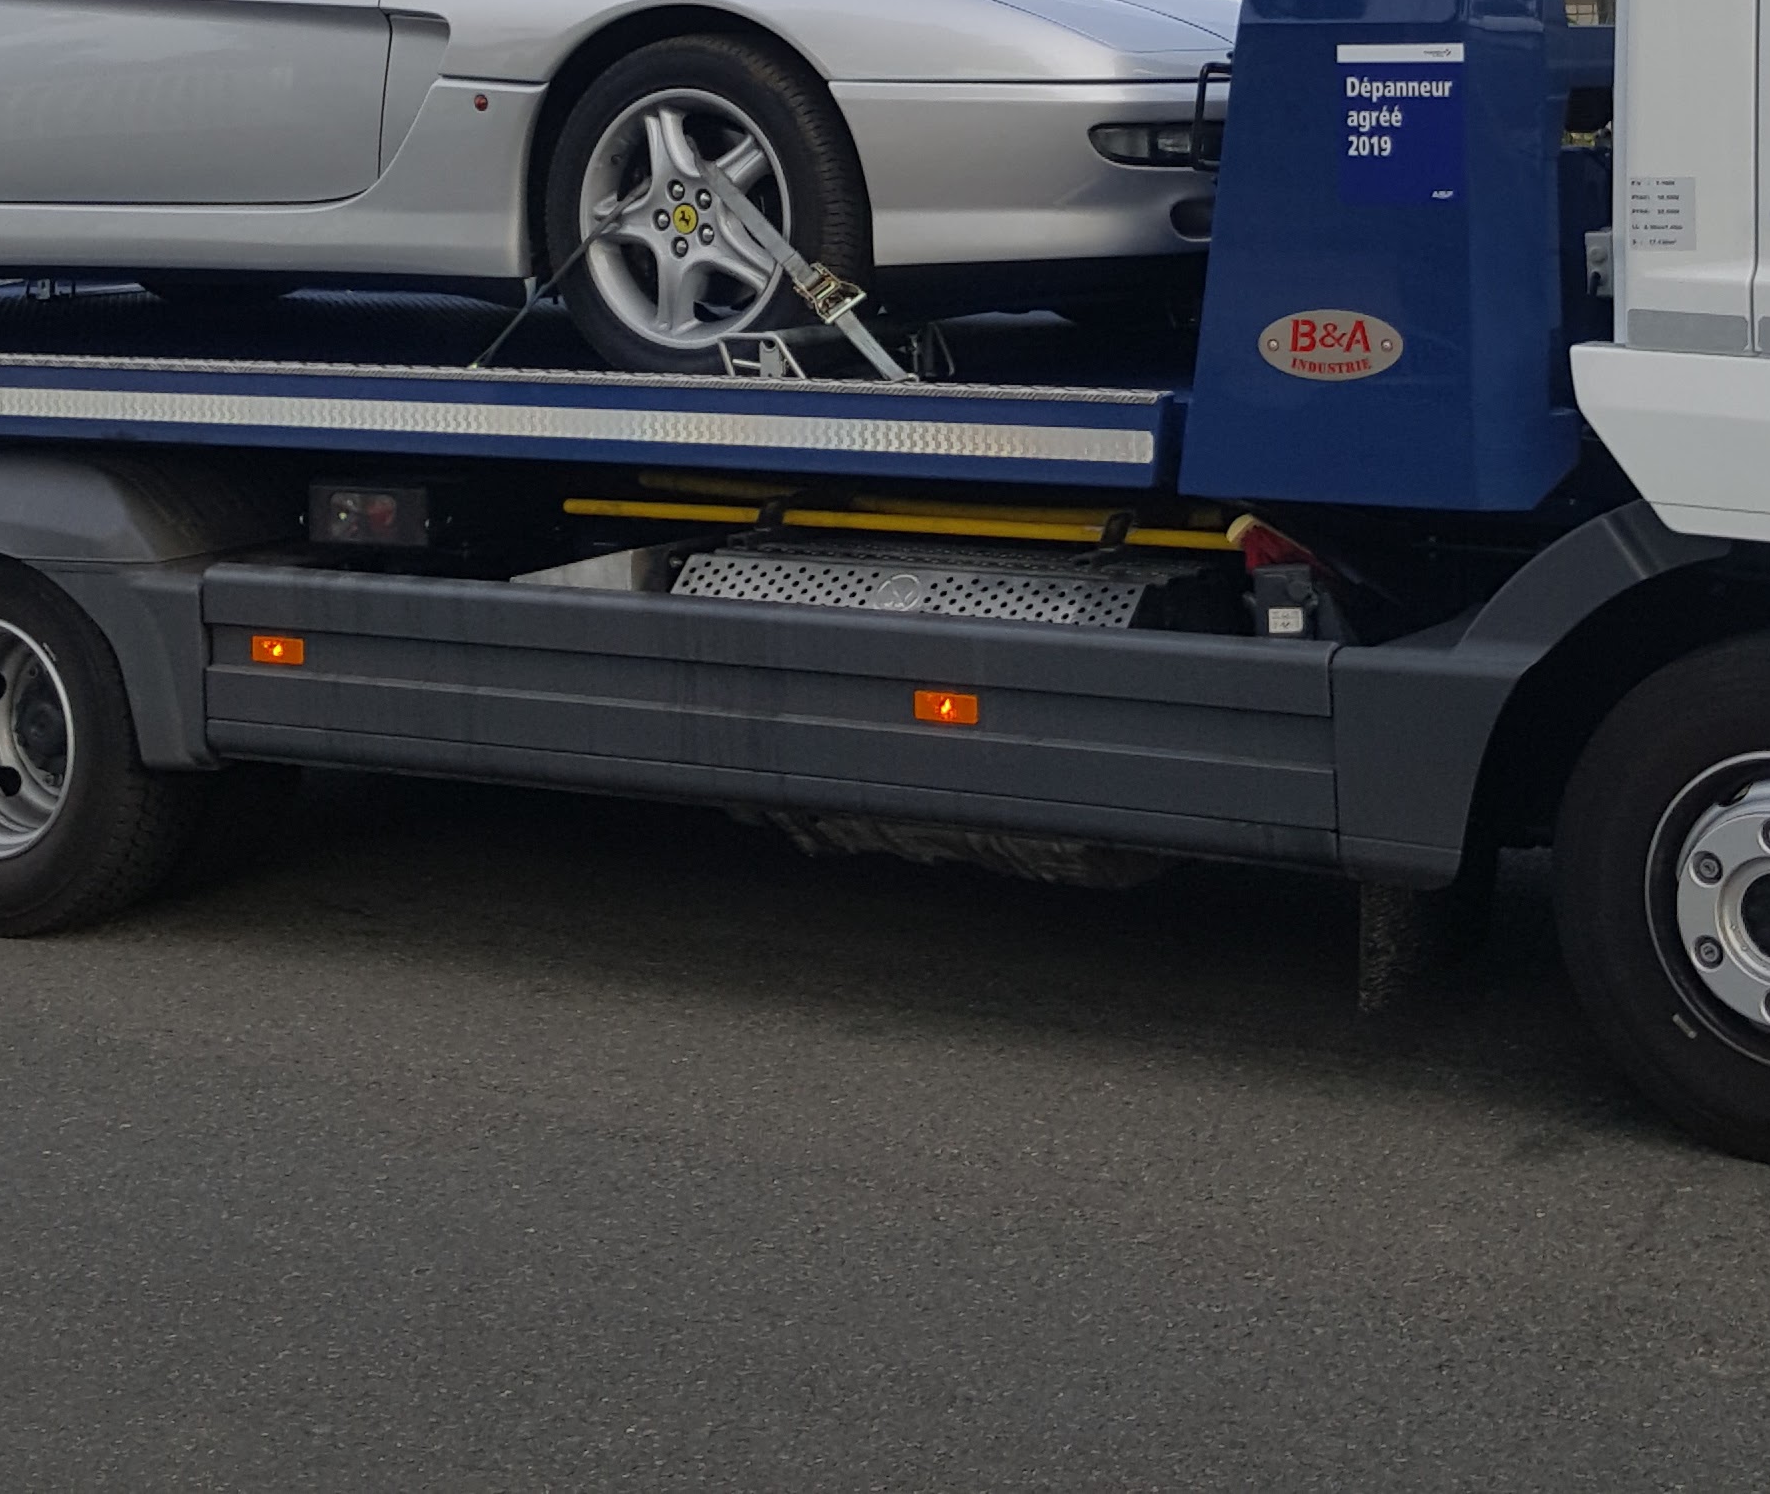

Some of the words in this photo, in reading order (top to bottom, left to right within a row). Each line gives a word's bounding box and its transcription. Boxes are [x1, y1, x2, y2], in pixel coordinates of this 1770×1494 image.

[1345, 76, 1453, 103] Dépanneur
[1347, 105, 1403, 132] agréé
[1348, 135, 1392, 156] 2019
[1290, 318, 1372, 354] B&A
[1290, 357, 1372, 375] INDUSTRIE
